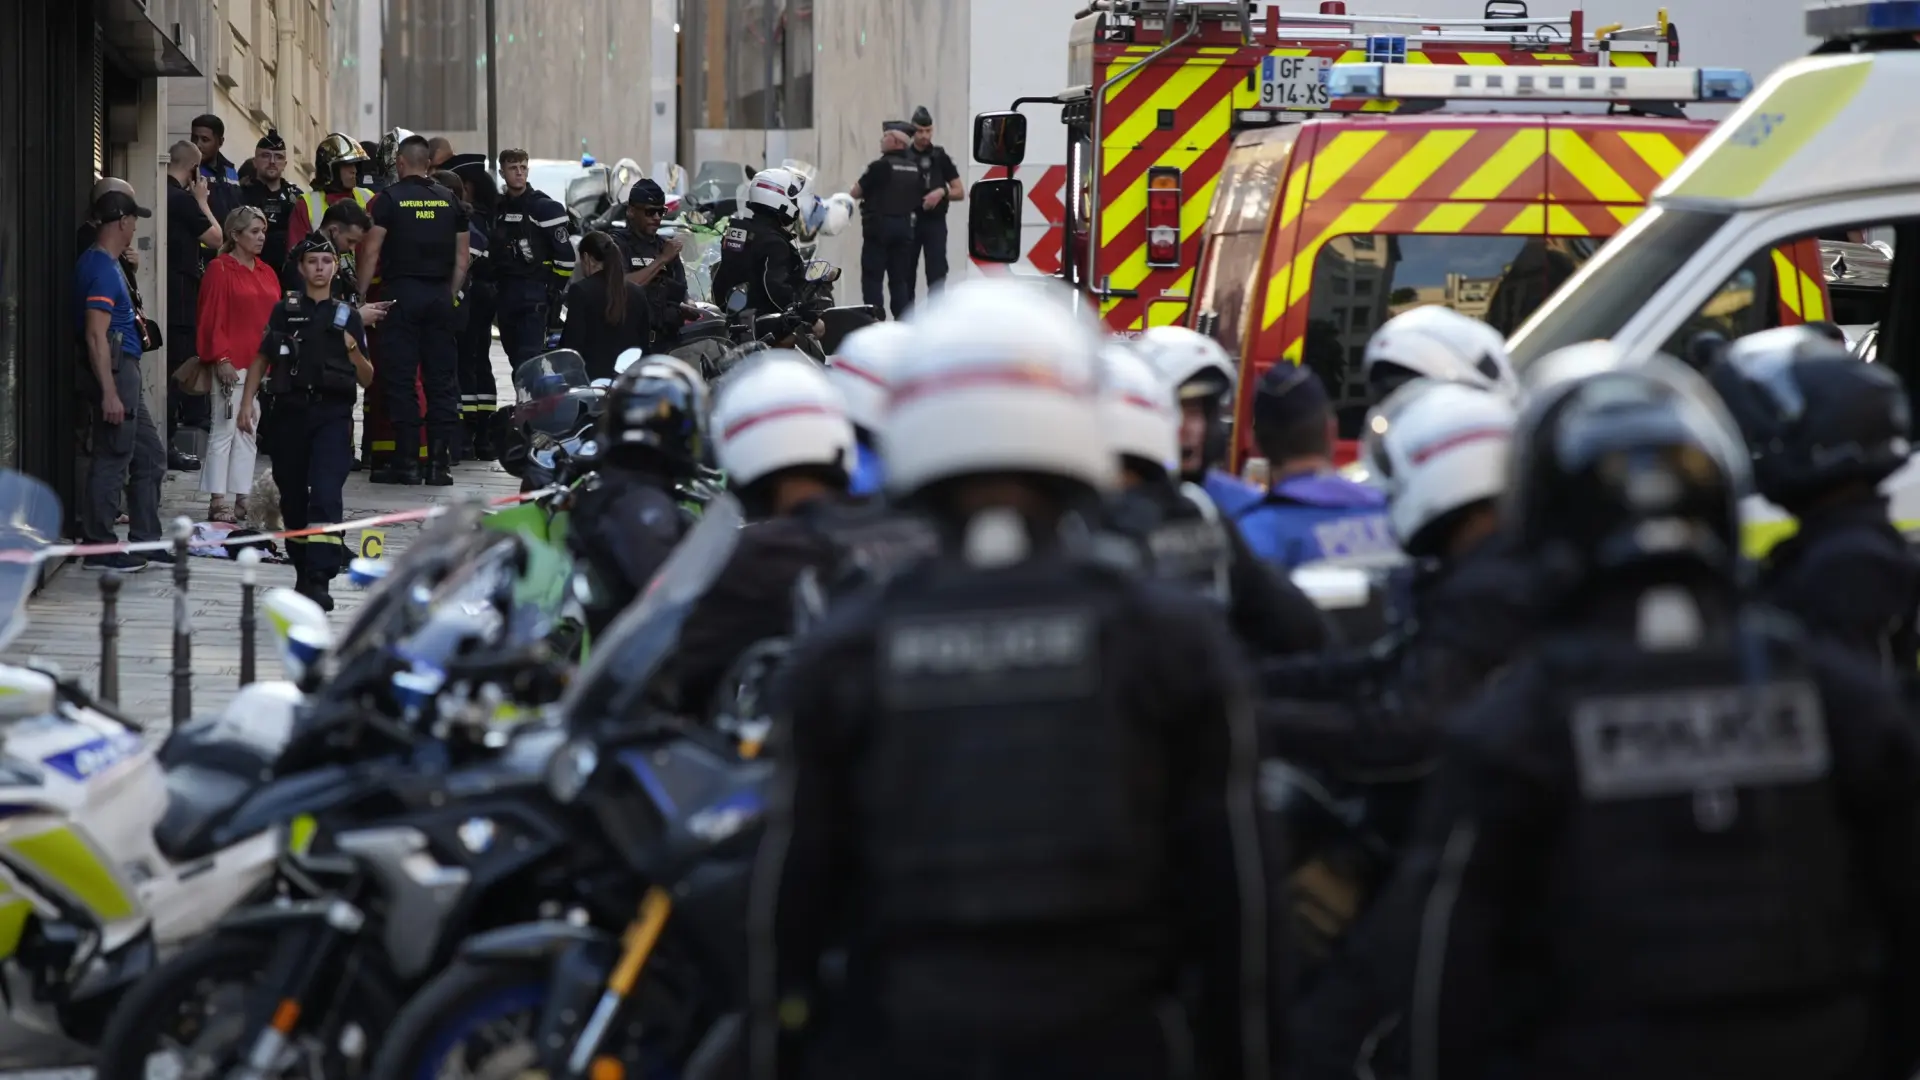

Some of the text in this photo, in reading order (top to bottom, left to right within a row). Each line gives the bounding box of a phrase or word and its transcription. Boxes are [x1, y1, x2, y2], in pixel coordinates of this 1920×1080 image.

[1263, 83, 1328, 104] 914-XS
[415, 210, 435, 219] PARIS
[362, 535, 381, 559] C
